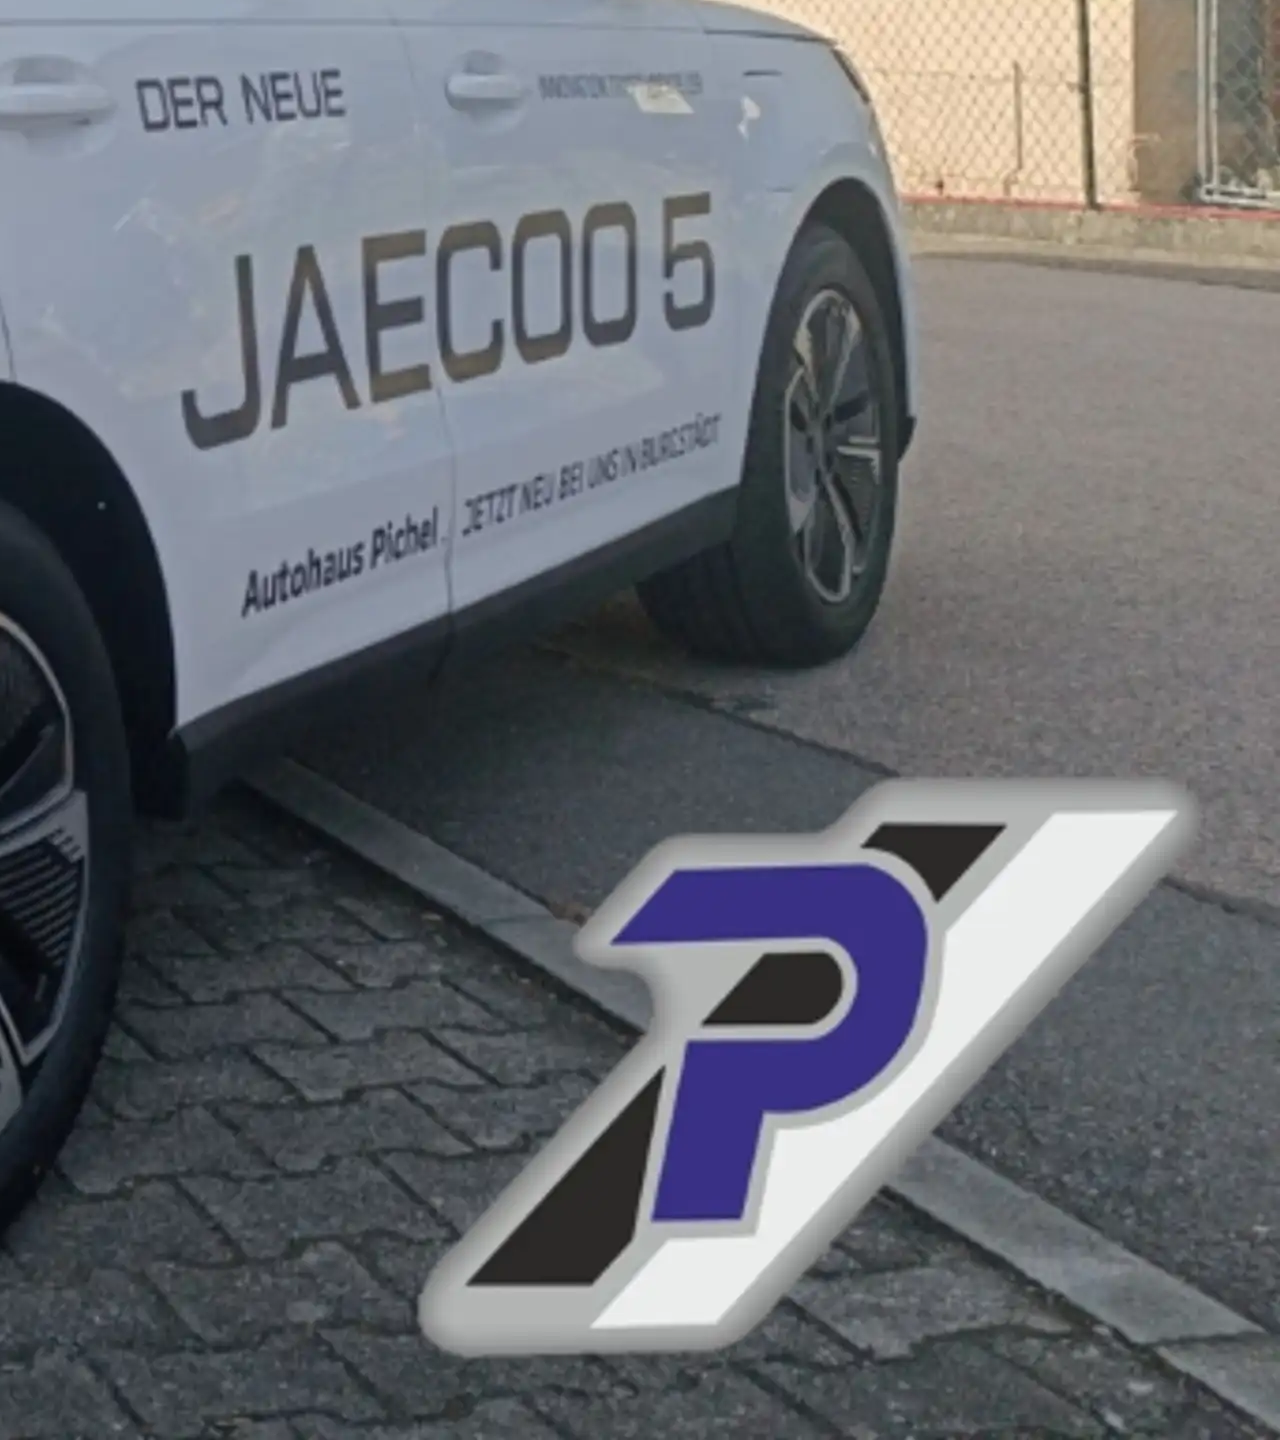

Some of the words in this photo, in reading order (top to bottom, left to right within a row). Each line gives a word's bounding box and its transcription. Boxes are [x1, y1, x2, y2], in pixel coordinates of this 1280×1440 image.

[135, 76, 228, 132] DER
[239, 68, 347, 125] NEUE
[180, 201, 637, 451] JAECOO
[662, 190, 716, 332] 5
[461, 482, 518, 537] JETZT
[518, 471, 555, 516] NEU
[558, 460, 584, 500] BEI
[587, 448, 620, 489] UNS
[241, 541, 365, 619] Autohaus
[370, 503, 438, 569] Pichel
